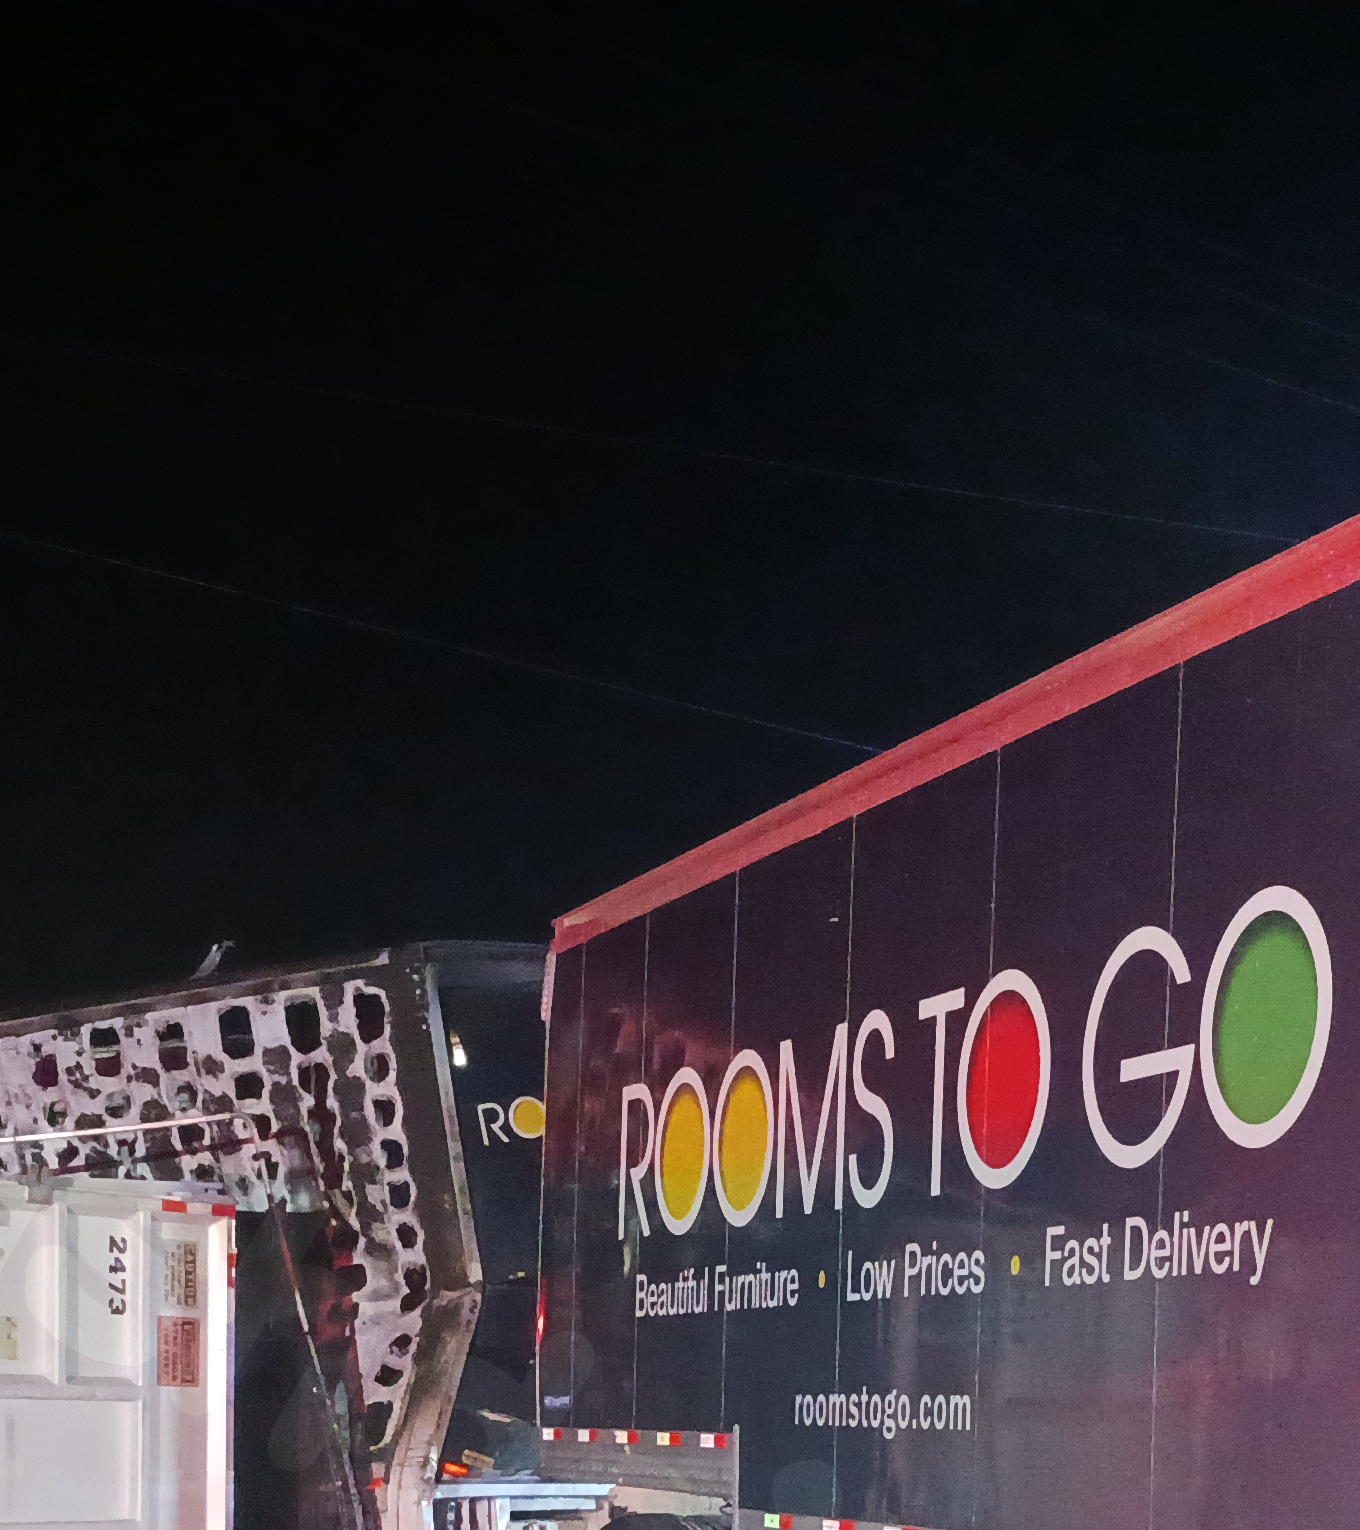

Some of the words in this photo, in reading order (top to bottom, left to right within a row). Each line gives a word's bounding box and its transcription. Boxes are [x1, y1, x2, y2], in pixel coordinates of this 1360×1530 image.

[618, 1009, 895, 1241] ROOMS
[919, 969, 1051, 1197] TO
[1082, 885, 1333, 1169] GO
[108, 1235, 128, 1315] 2473
[634, 1266, 709, 1317] Beautiful
[714, 1261, 799, 1312] Furniture
[847, 1250, 896, 1301] Low
[903, 1240, 985, 1297] Prices
[1044, 1222, 1111, 1287] Fast
[1123, 1210, 1274, 1286] Delivery
[794, 1385, 971, 1440] roomstogo.com
